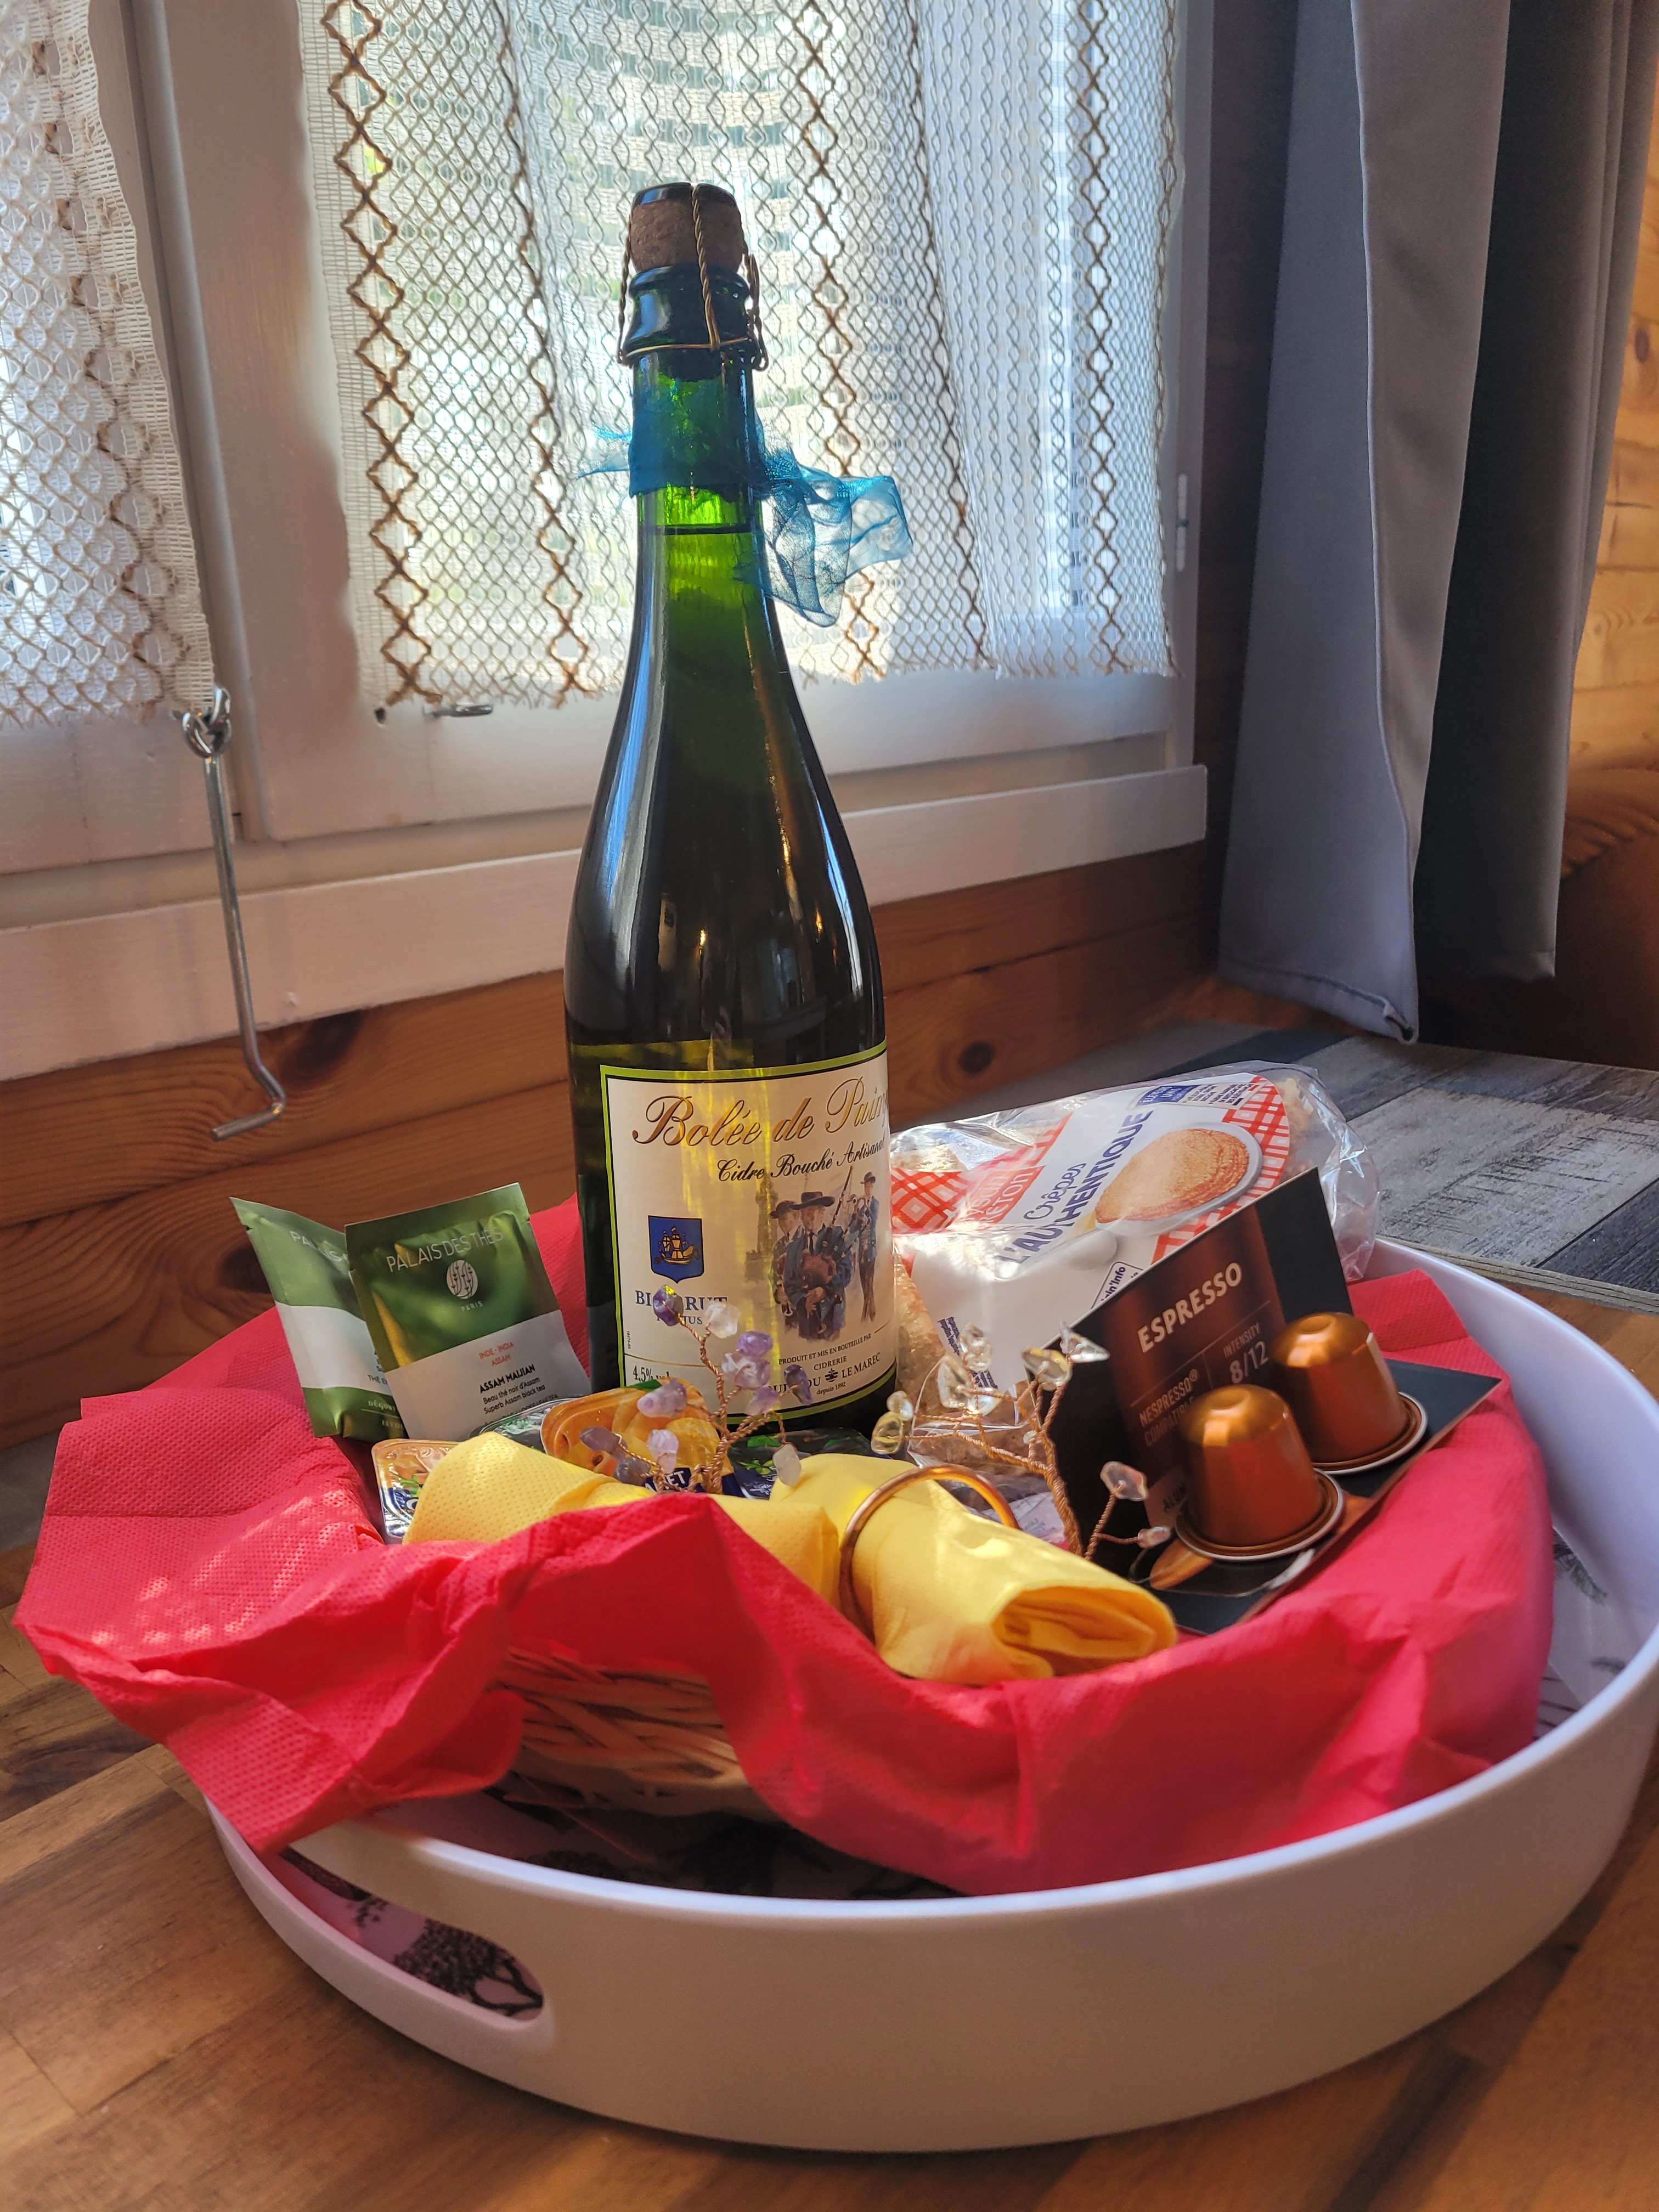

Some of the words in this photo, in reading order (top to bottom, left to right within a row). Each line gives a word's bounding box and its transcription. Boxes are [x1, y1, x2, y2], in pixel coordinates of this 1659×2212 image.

[632, 1095, 762, 1146] Bolée
[772, 1097, 815, 1142] de
[717, 1159, 765, 1181] Cidre
[770, 1148, 834, 1178] Bouché
[386, 1243, 442, 1273] PALAIS
[441, 1234, 472, 1257] DES
[460, 1300, 484, 1312] PARIS
[1137, 1262, 1242, 1353] ESPRESSO
[478, 1348, 494, 1360] INDE
[498, 1341, 515, 1353] INDIA
[778, 1354, 808, 1365] PRODUIT
[817, 1348, 828, 1357] MIS
[837, 1336, 864, 1352] BOUTEILLE
[862, 1333, 872, 1343] PAR
[1223, 1322, 1261, 1359] INTENSITY
[492, 1353, 512, 1367] ASSAM
[813, 1356, 847, 1371] CIDRERIE
[842, 1366, 853, 1379] LE
[853, 1352, 881, 1375] MAREC
[1229, 1340, 1270, 1384] 8/12
[479, 1375, 506, 1394] ASSAM
[505, 1363, 536, 1383] MAIJIAN
[483, 1393, 499, 1405] Beau
[498, 1388, 508, 1399] thé
[508, 1384, 520, 1396] noir
[519, 1377, 541, 1390] d'Assam
[816, 1385, 835, 1396] depuis
[834, 1381, 847, 1391] 1892
[483, 1400, 504, 1414] Superb
[504, 1394, 522, 1407] Assam
[521, 1387, 537, 1400] black
[536, 1384, 546, 1393] tea
